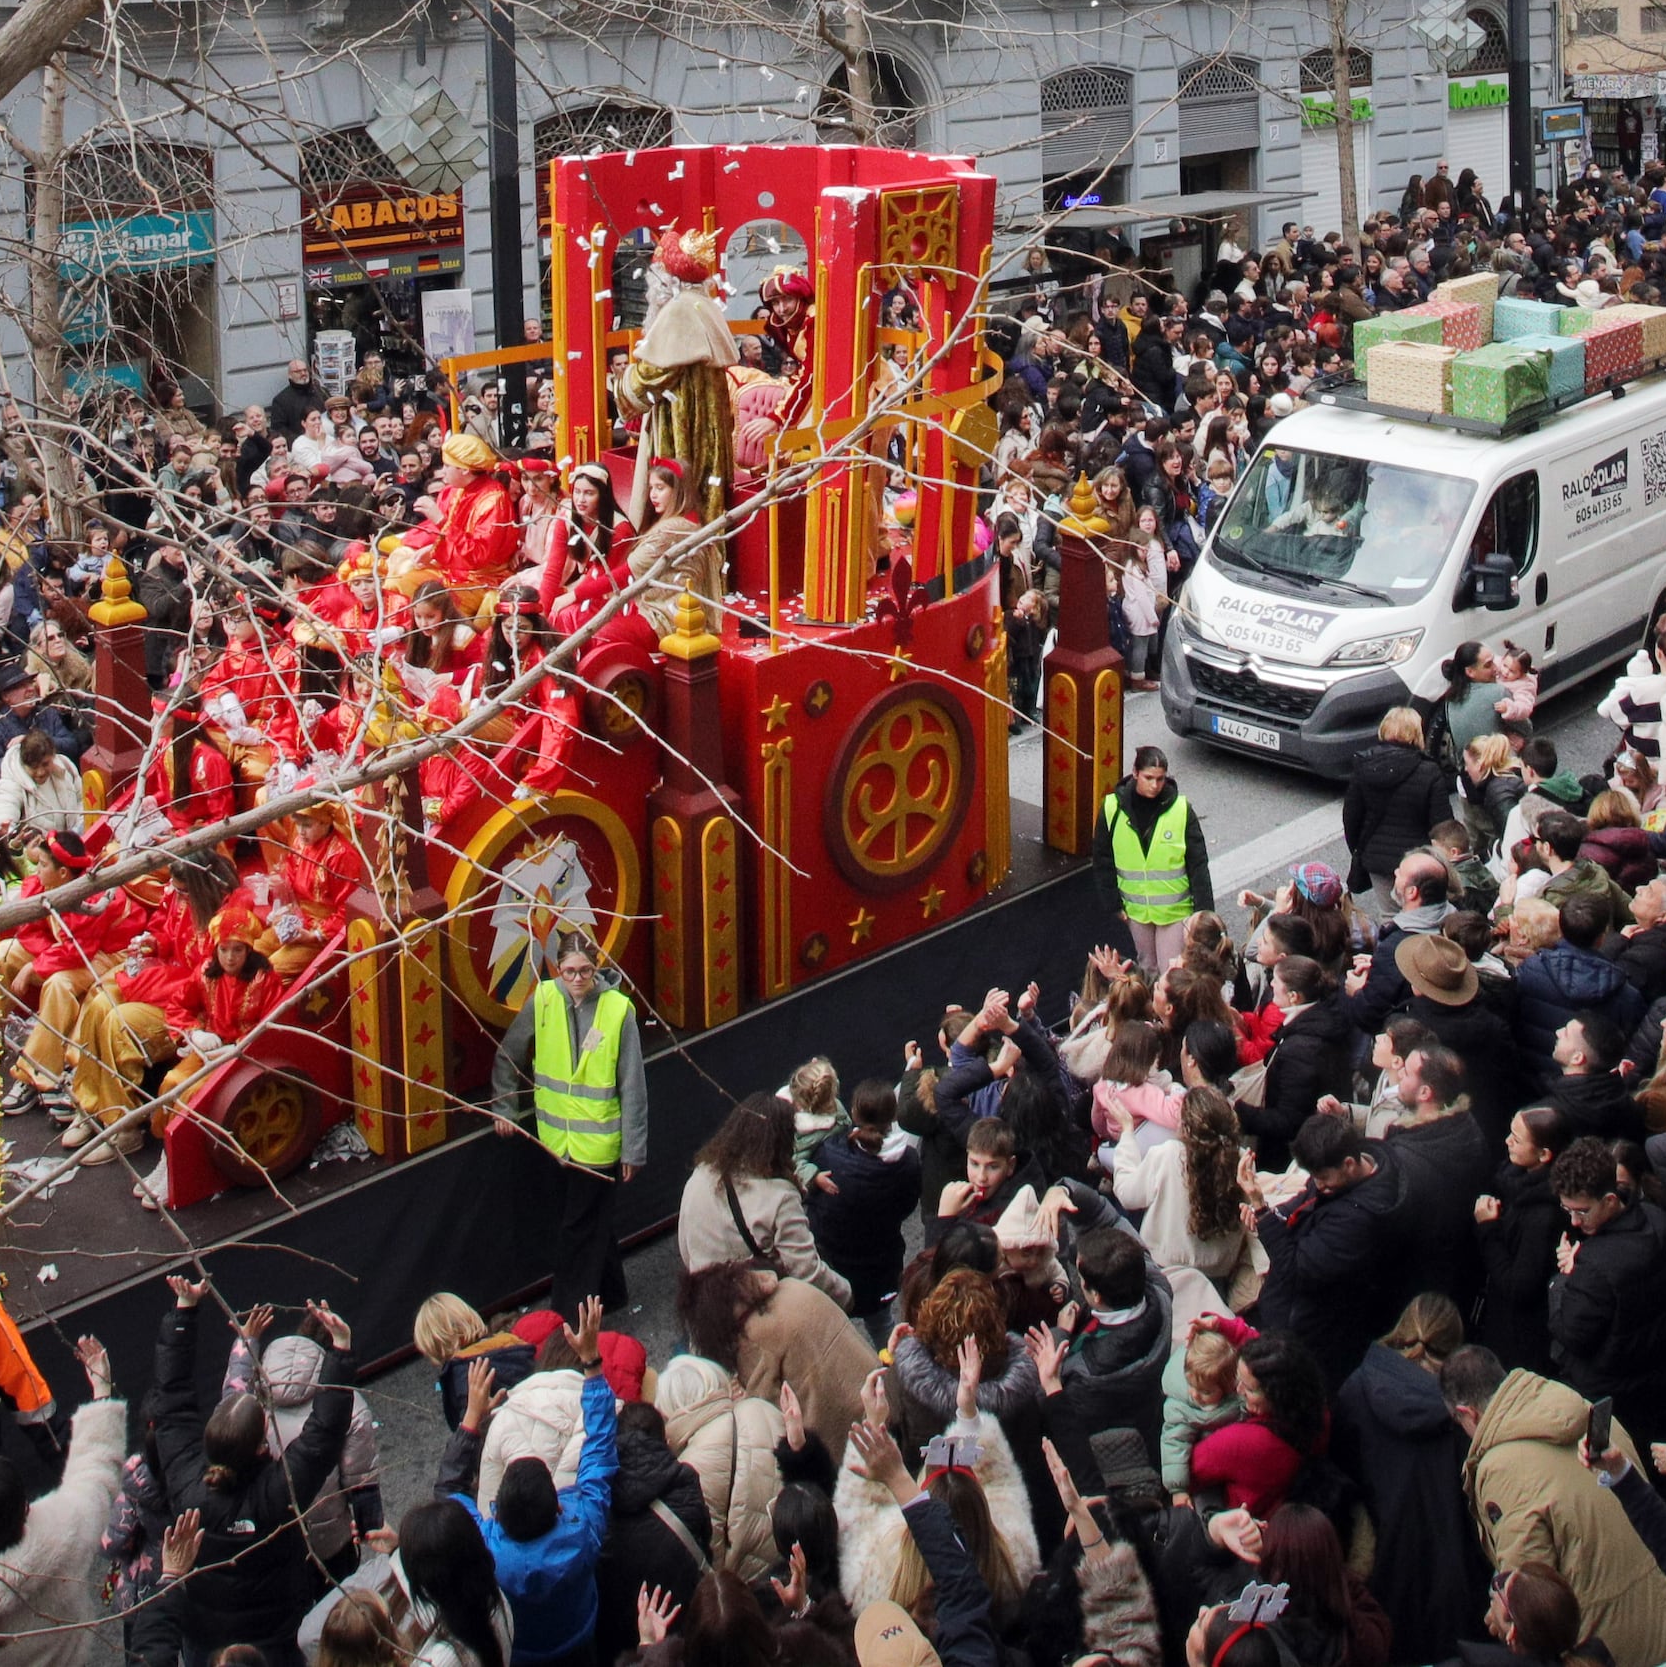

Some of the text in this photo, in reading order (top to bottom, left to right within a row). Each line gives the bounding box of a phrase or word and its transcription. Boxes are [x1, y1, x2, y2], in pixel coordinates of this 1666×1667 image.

[334, 271, 363, 283] TOBACCO
[1575, 507, 1592, 524] 605
[1224, 624, 1303, 654] 605 41 33 65
[1220, 720, 1277, 748] 4447 JCR
